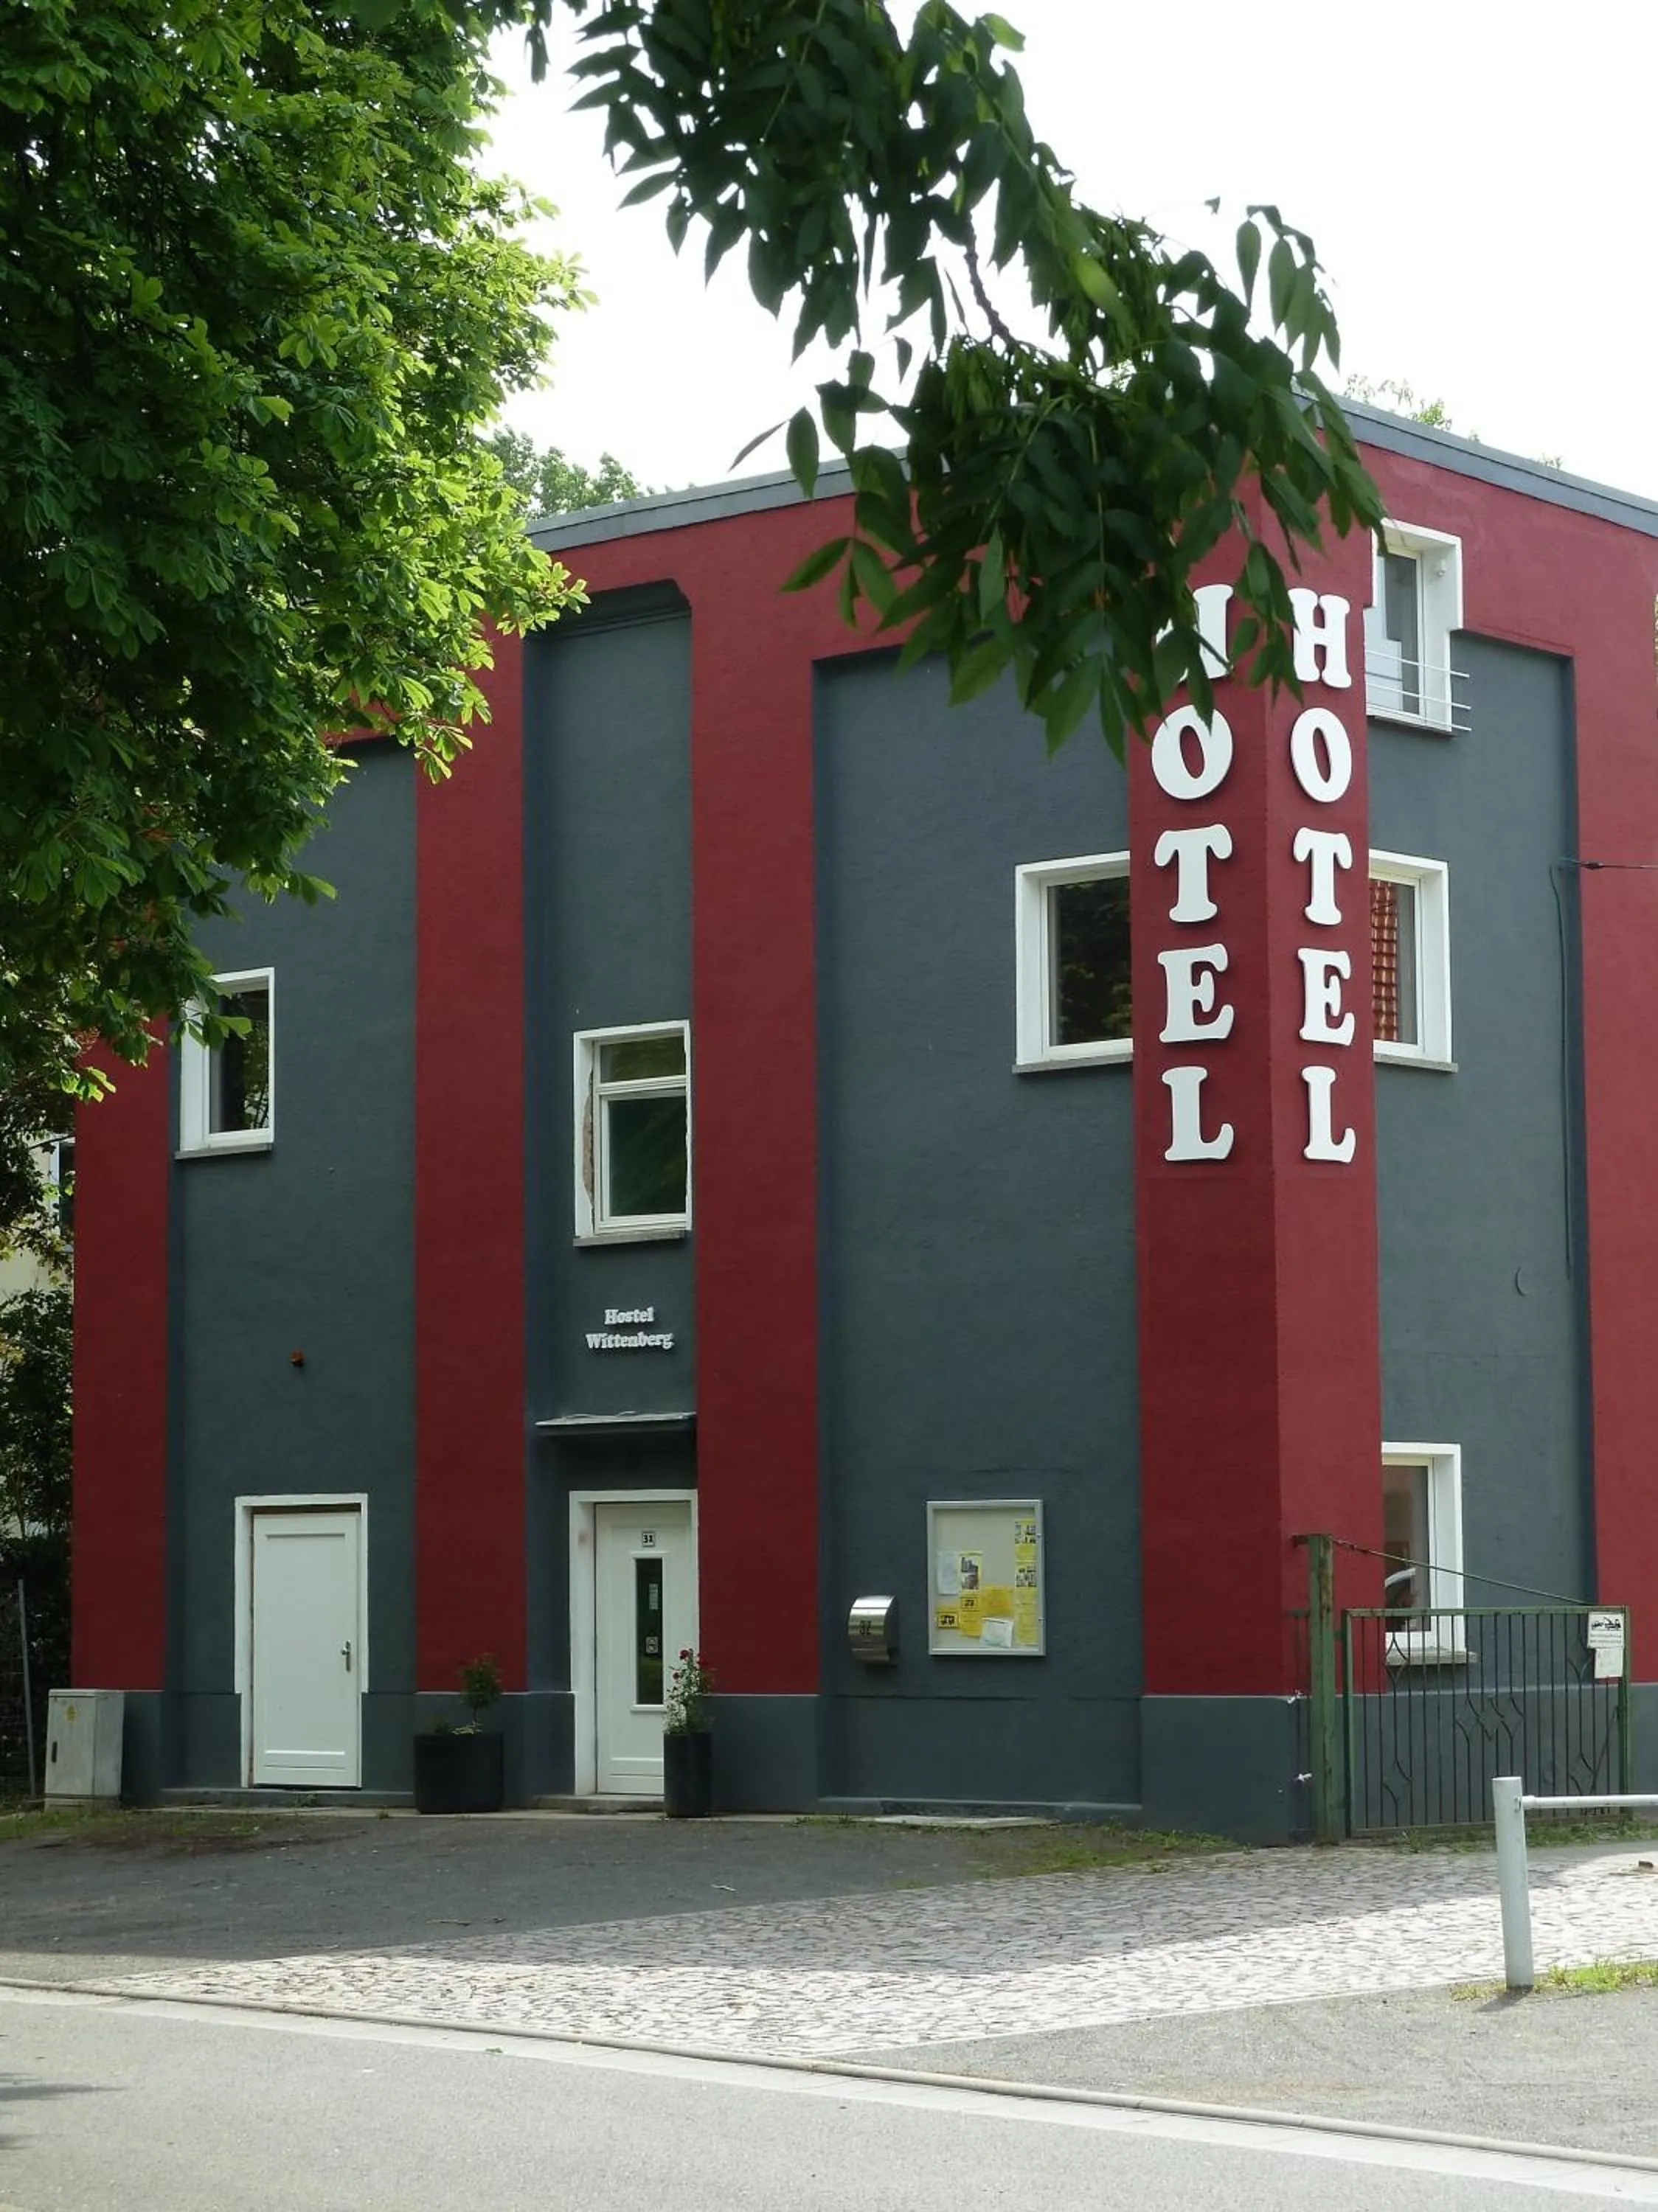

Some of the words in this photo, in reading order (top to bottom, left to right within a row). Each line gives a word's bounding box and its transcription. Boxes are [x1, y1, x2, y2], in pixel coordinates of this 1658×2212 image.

[1287, 587, 1356, 1164] HOTEL
[604, 1306, 654, 1325] Hostel
[585, 1331, 676, 1350] Wittenberg
